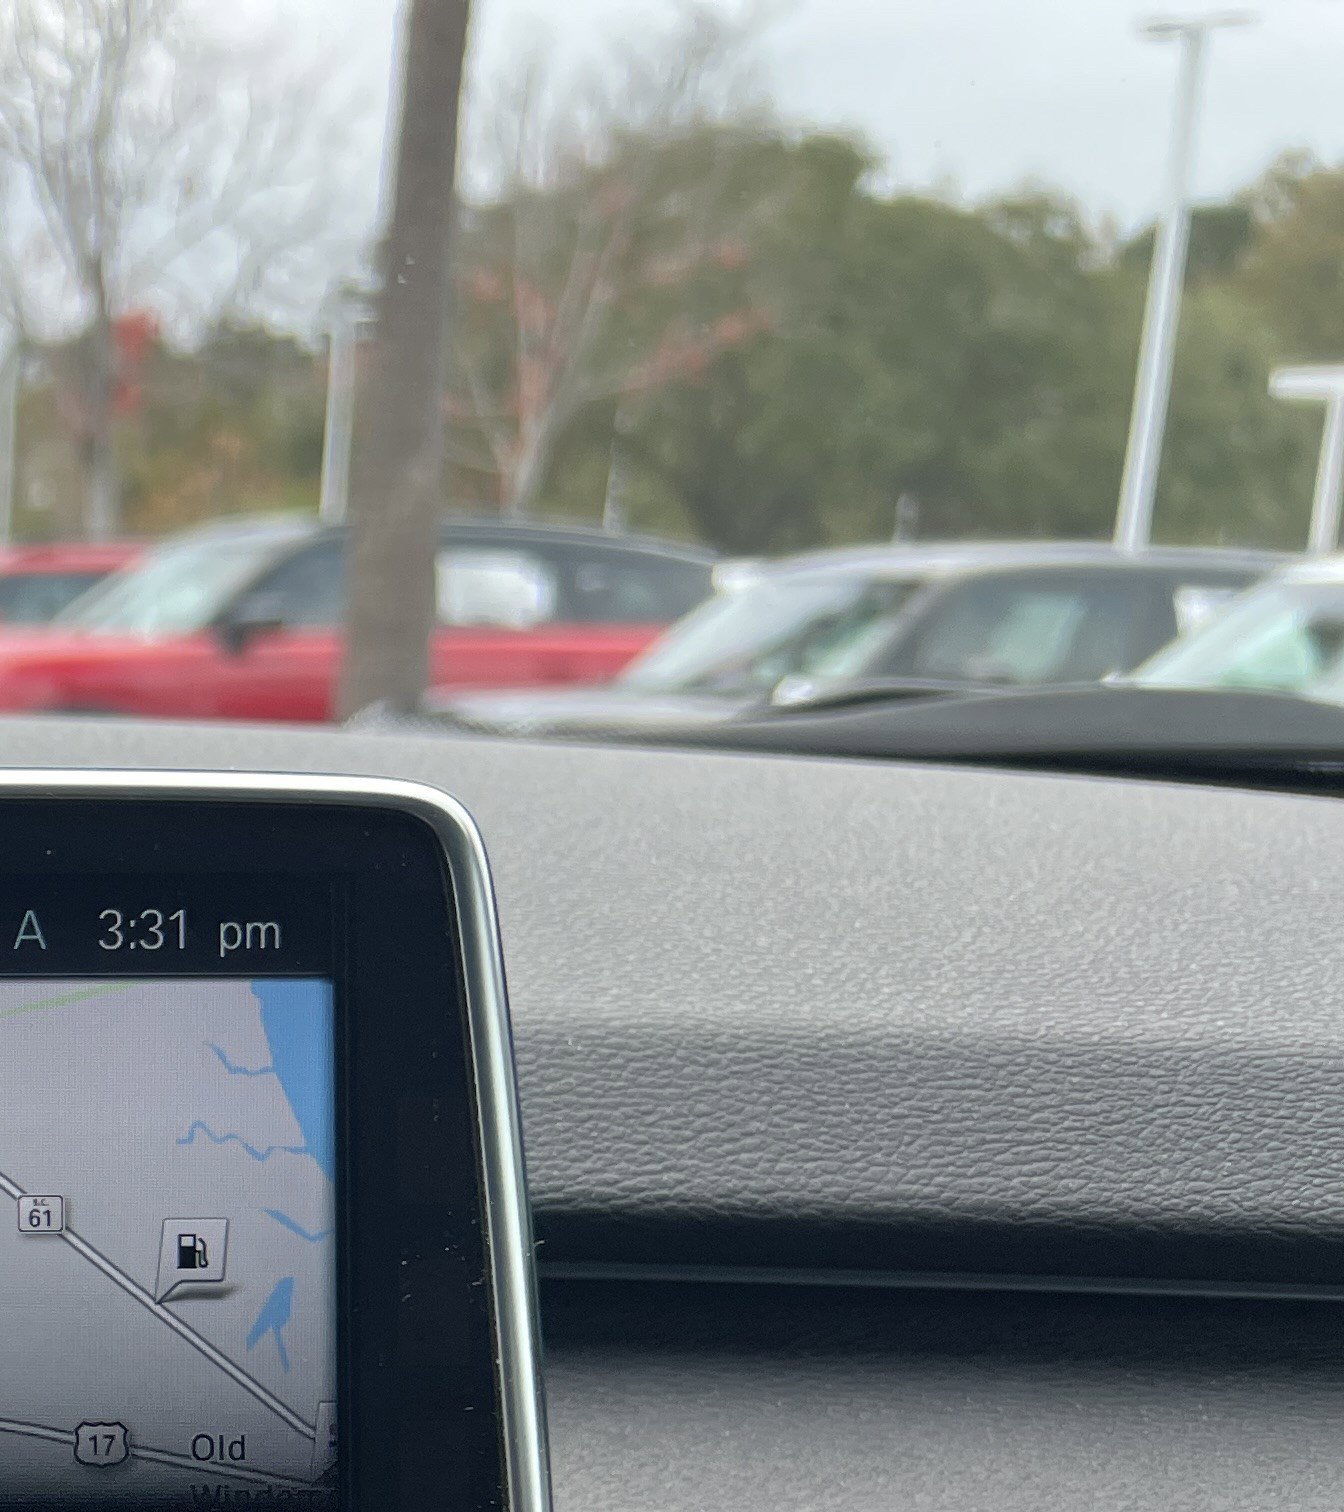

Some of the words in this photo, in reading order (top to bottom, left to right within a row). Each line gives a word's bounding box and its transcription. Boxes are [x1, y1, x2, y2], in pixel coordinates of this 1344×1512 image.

[13, 909, 47, 950] A
[98, 909, 186, 950] 3:31
[219, 922, 280, 957] pm
[29, 1208, 51, 1228] 61
[88, 1434, 116, 1456] 17
[191, 1433, 246, 1461] Old
